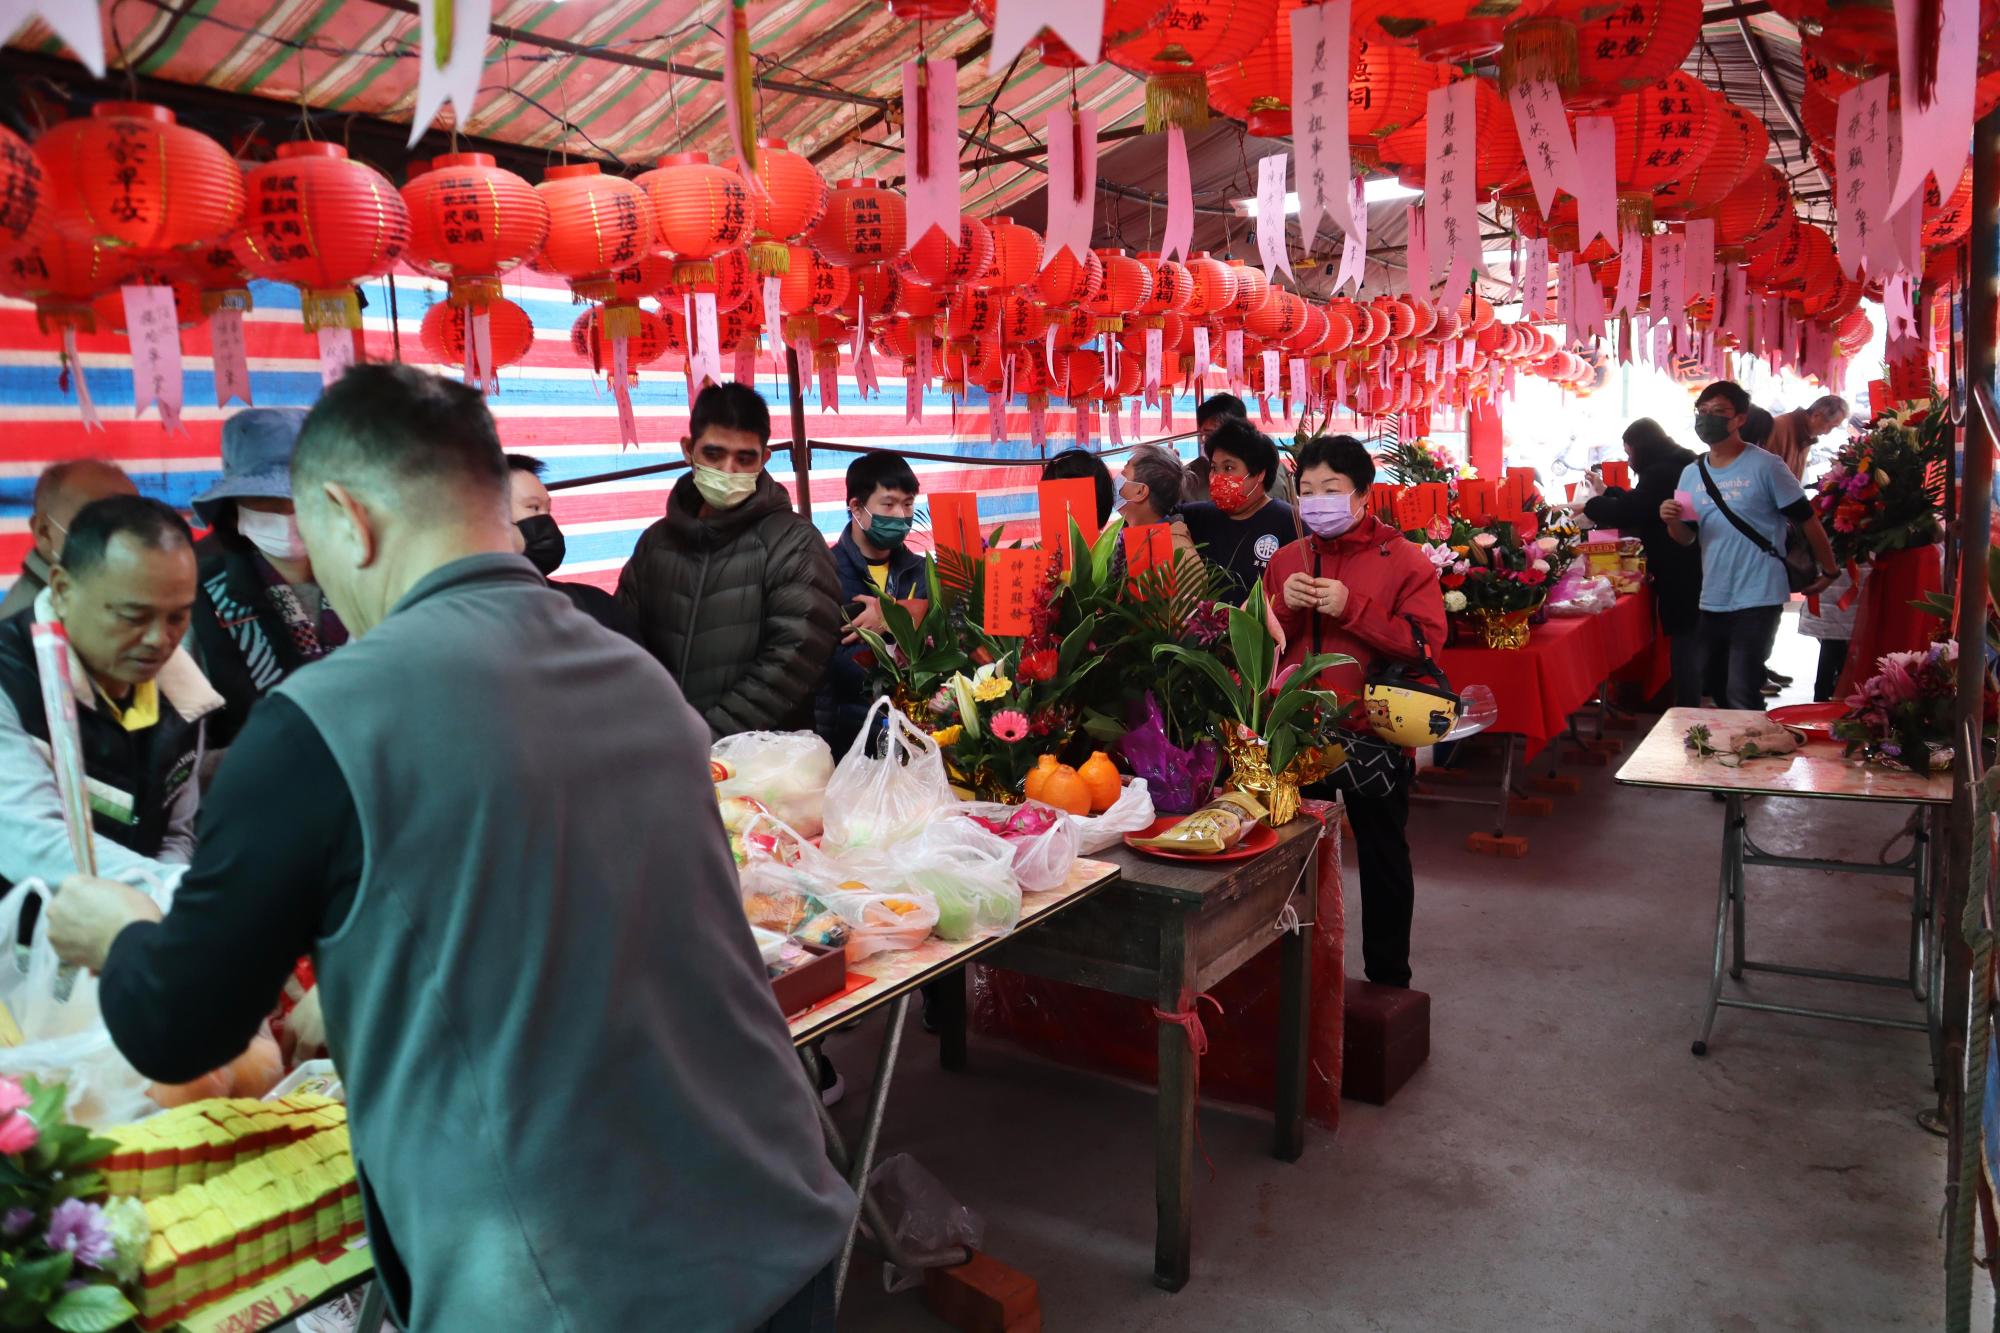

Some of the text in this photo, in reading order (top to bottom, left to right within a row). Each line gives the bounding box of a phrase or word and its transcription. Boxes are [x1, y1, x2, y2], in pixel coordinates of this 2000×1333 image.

[612, 193, 638, 264] 福德正神
[714, 181, 746, 244] 福德祠
[1155, 264, 1175, 303] 福德祠
[971, 289, 988, 331] 福德正神
